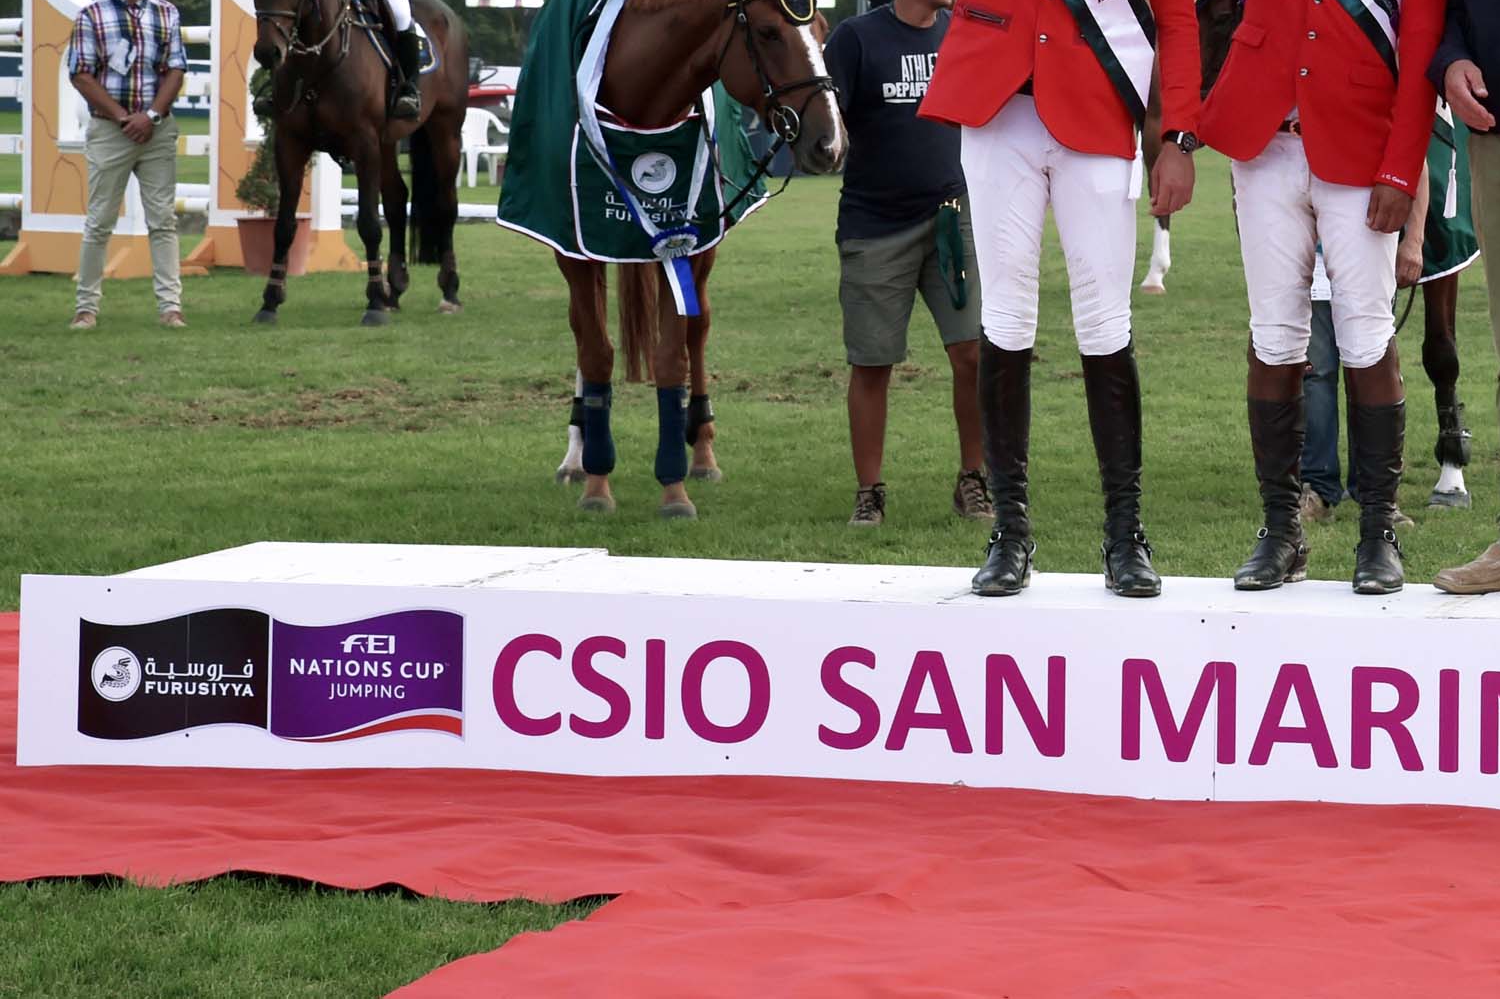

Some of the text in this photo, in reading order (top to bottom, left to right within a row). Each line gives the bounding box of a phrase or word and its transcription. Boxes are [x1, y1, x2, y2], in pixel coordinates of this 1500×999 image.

[340, 634, 396, 655] FEI
[144, 658, 254, 681] فروسية
[289, 658, 445, 679] NATIONS CUP
[145, 681, 254, 697] FURUSIYYA
[328, 682, 405, 700] JUMPING
[492, 633, 772, 745] CSIO
[818, 645, 1067, 758] SAN
